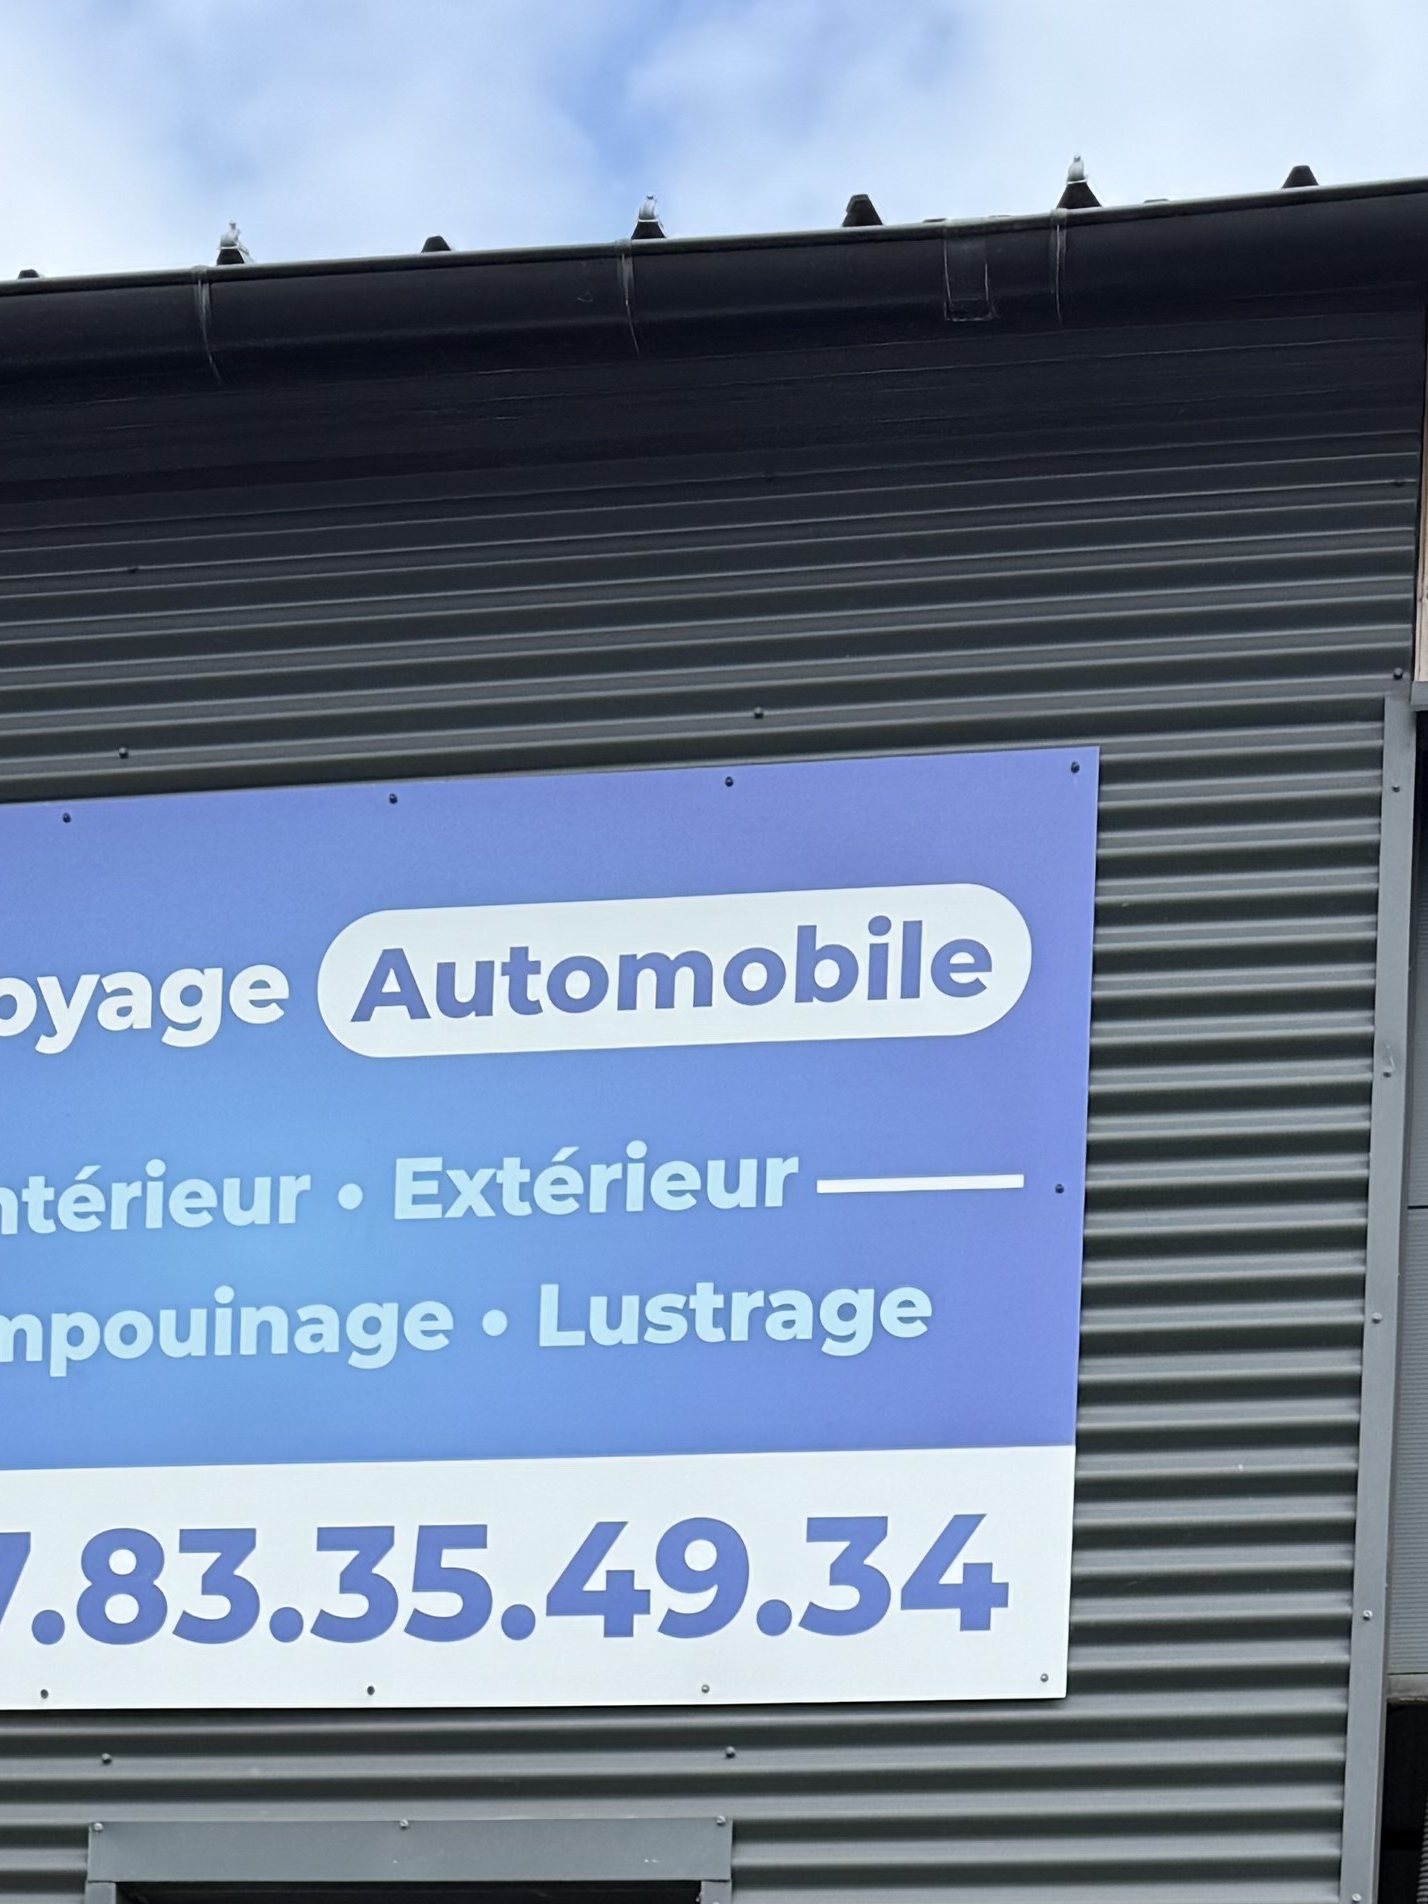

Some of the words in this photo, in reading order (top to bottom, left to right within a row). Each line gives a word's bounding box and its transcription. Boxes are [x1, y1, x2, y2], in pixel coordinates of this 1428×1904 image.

[352, 916, 994, 1024] Automobile
[393, 1142, 800, 1225] Extérieur
[539, 1275, 934, 1361] Lustrage
